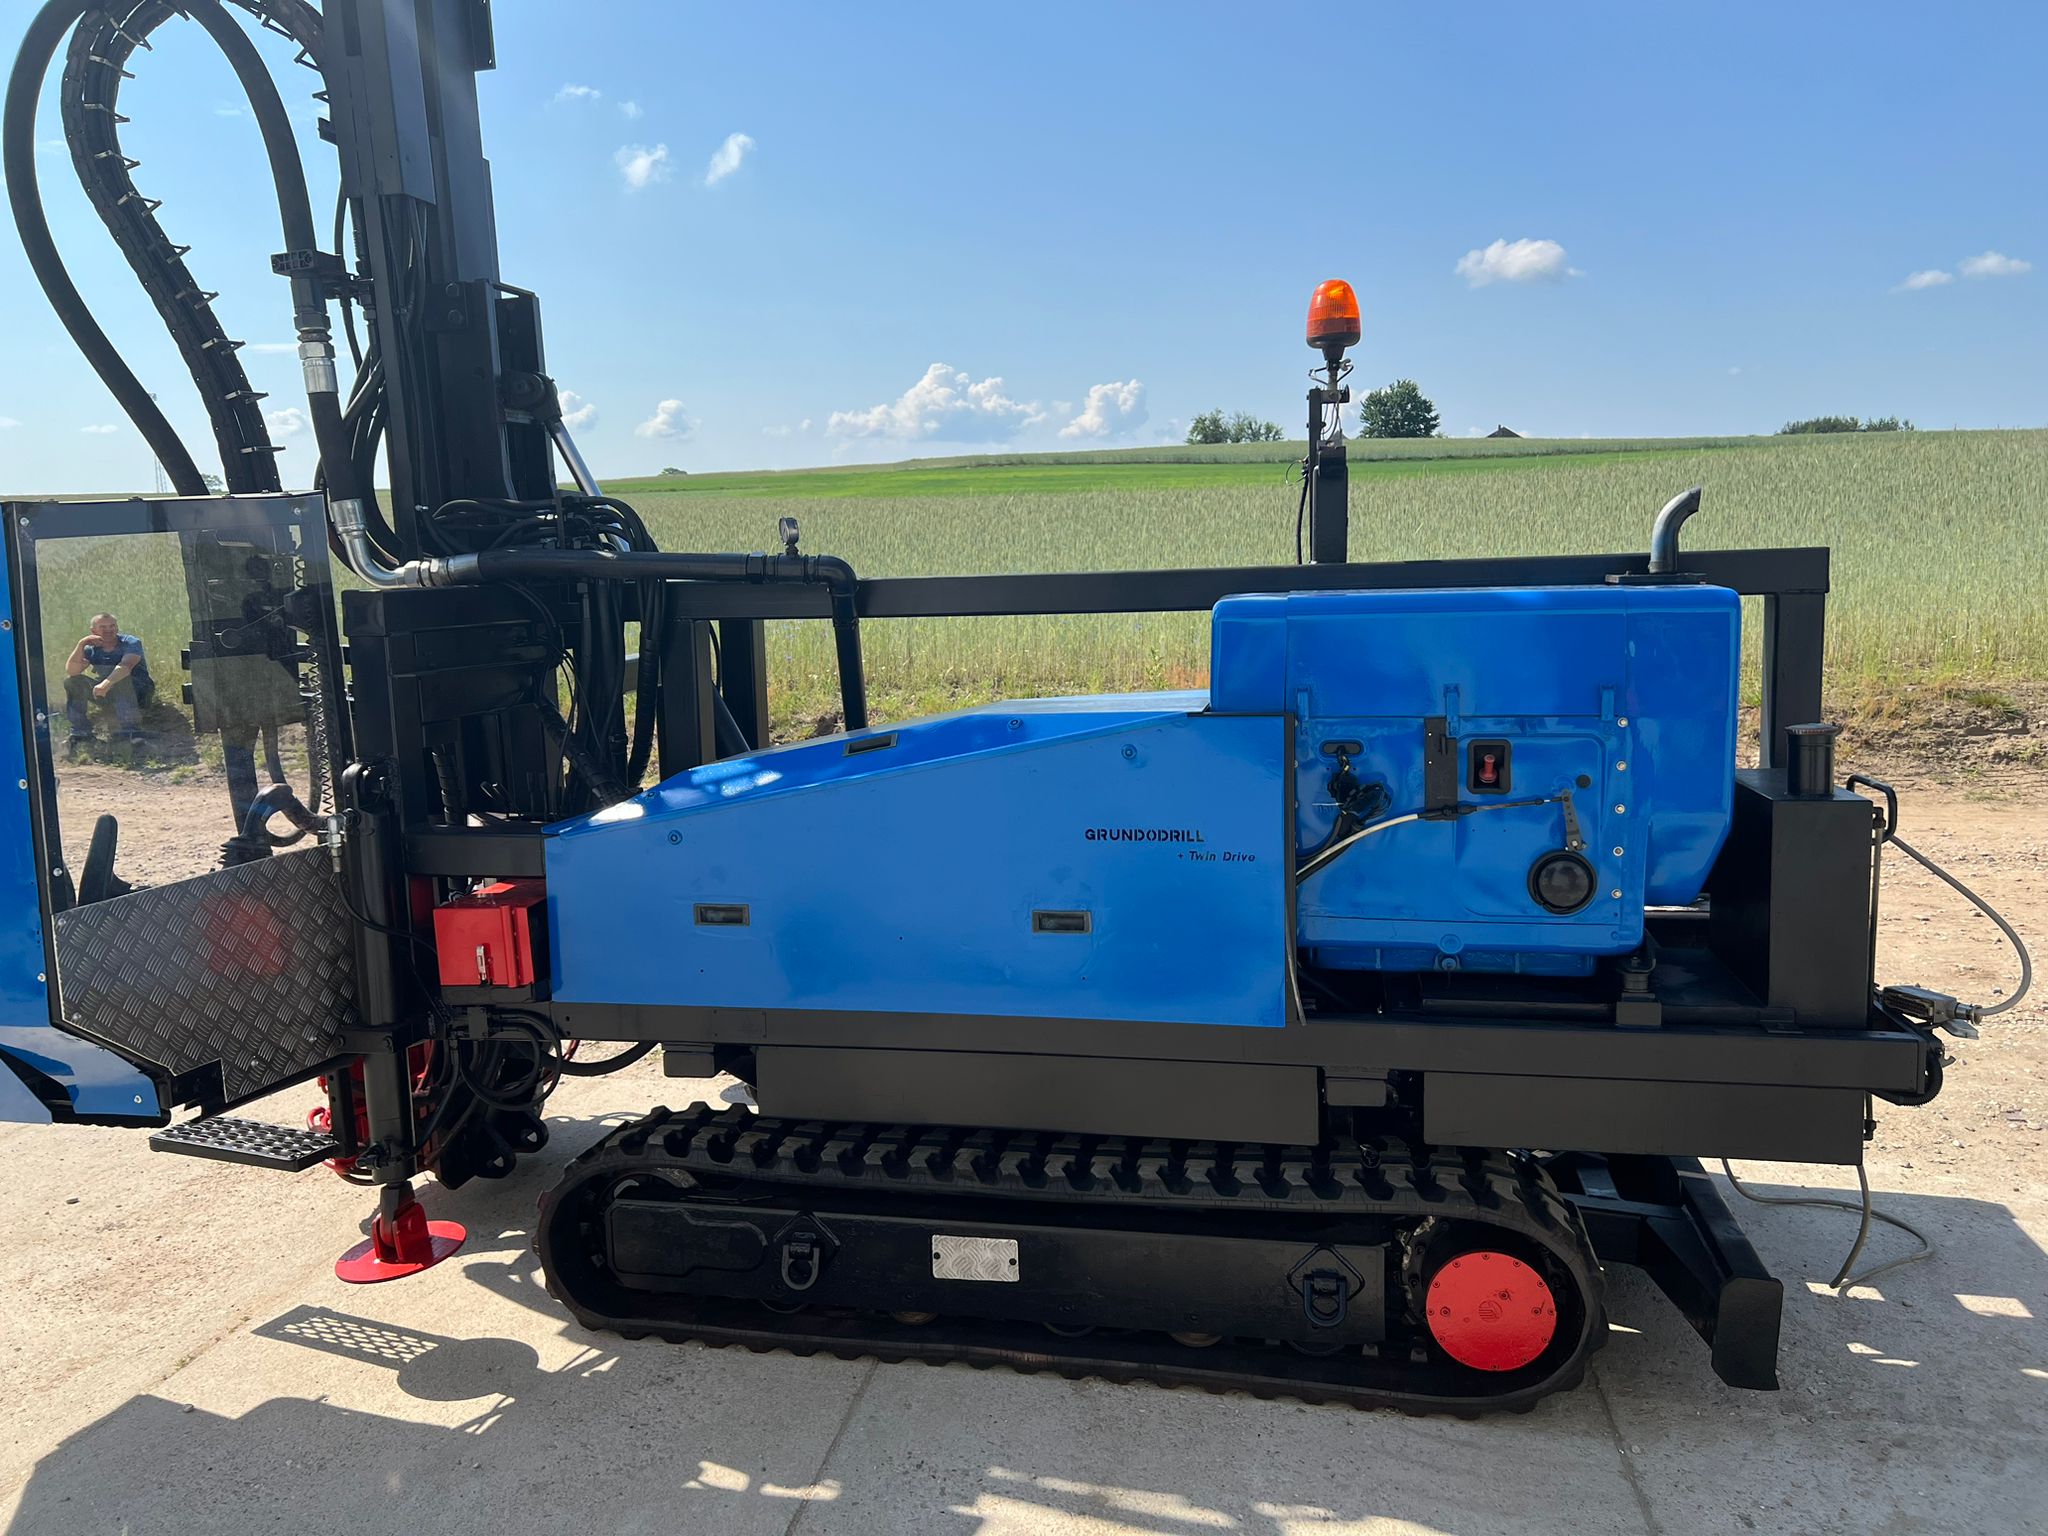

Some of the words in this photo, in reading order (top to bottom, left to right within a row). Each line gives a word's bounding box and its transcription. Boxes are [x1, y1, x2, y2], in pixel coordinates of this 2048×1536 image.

[1085, 828, 1205, 842] GRUNDODRILL
[1189, 850, 1217, 862] Twin
[1223, 851, 1256, 862] Drive
